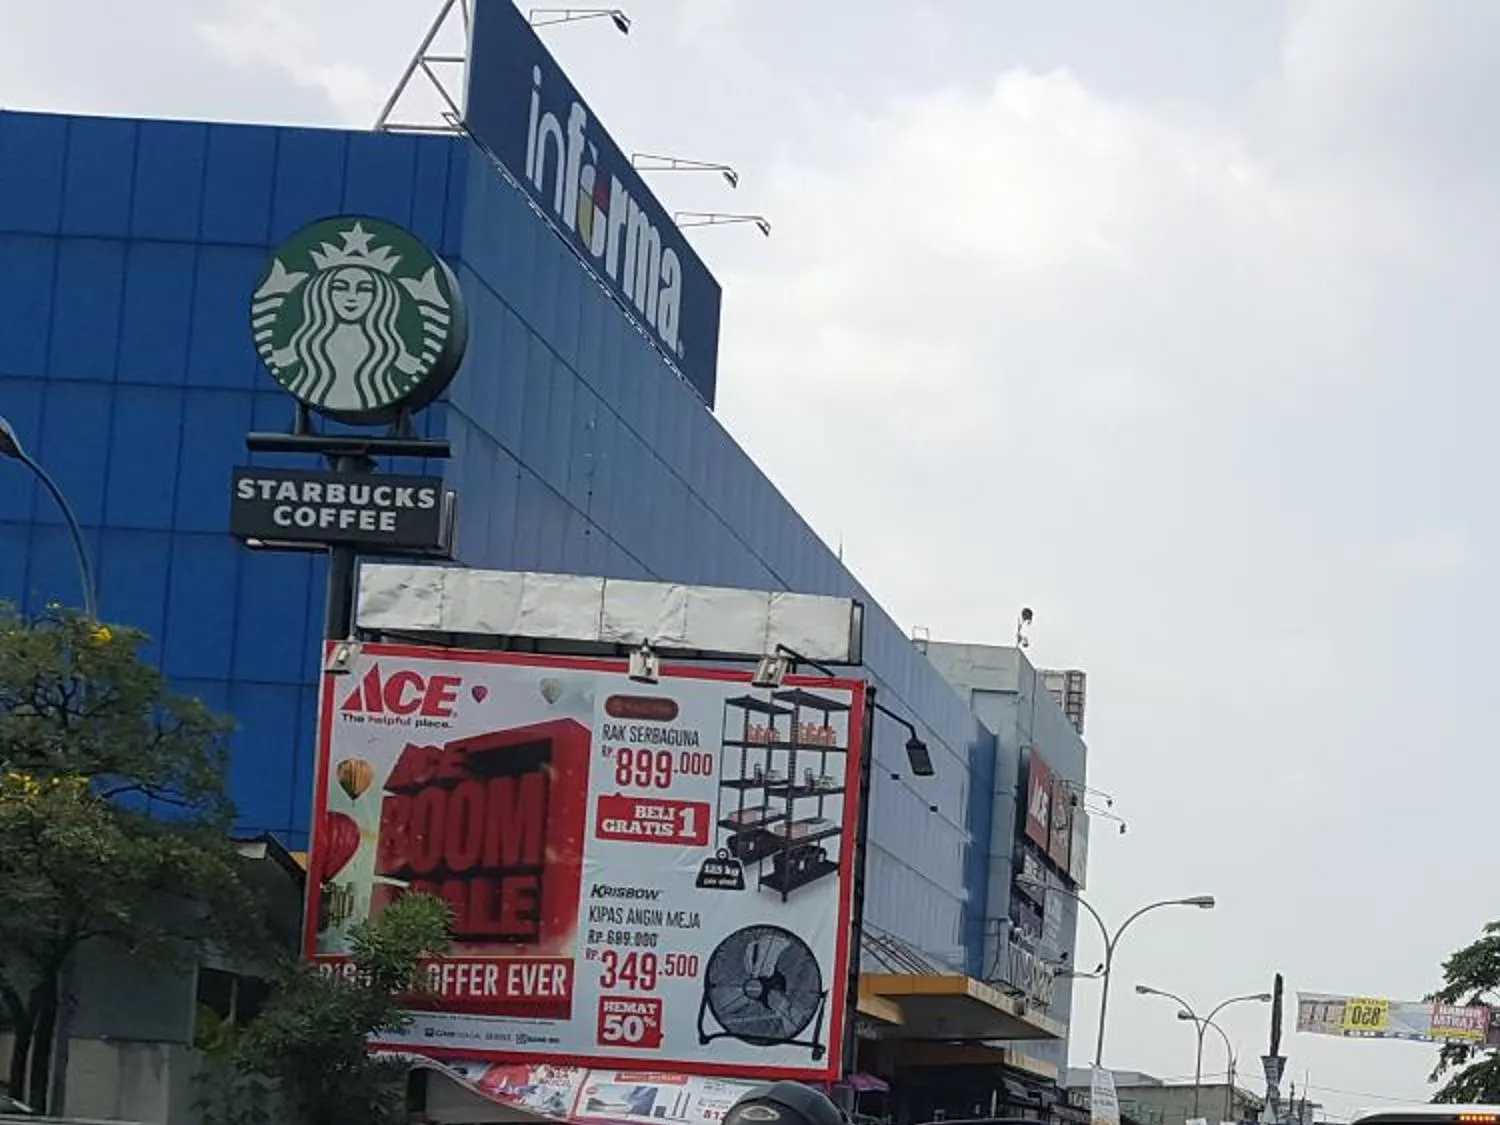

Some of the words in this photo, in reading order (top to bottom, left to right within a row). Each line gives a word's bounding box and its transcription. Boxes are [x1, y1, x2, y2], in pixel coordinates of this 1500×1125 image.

[525, 66, 683, 350] informa
[236, 477, 436, 511] STARBUCKS
[273, 505, 397, 532] COFFEE
[341, 662, 463, 717] ACE
[342, 712, 365, 723] The
[367, 714, 411, 727] helpful
[602, 723, 626, 742] RAK
[629, 725, 700, 747] SERBAGUNA
[376, 772, 545, 876] BOOM
[602, 818, 675, 837] GRATIS
[634, 804, 675, 821] BELI
[679, 806, 697, 838] 1
[590, 884, 660, 900] KRISBOW
[589, 905, 623, 925] KIPAS
[626, 908, 664, 927] ANGIN
[666, 911, 701, 929] MEJA
[427, 963, 498, 996] OFFER
[507, 963, 567, 997] EVER
[600, 950, 700, 991] 349.500
[603, 1001, 657, 1014] HEMAT
